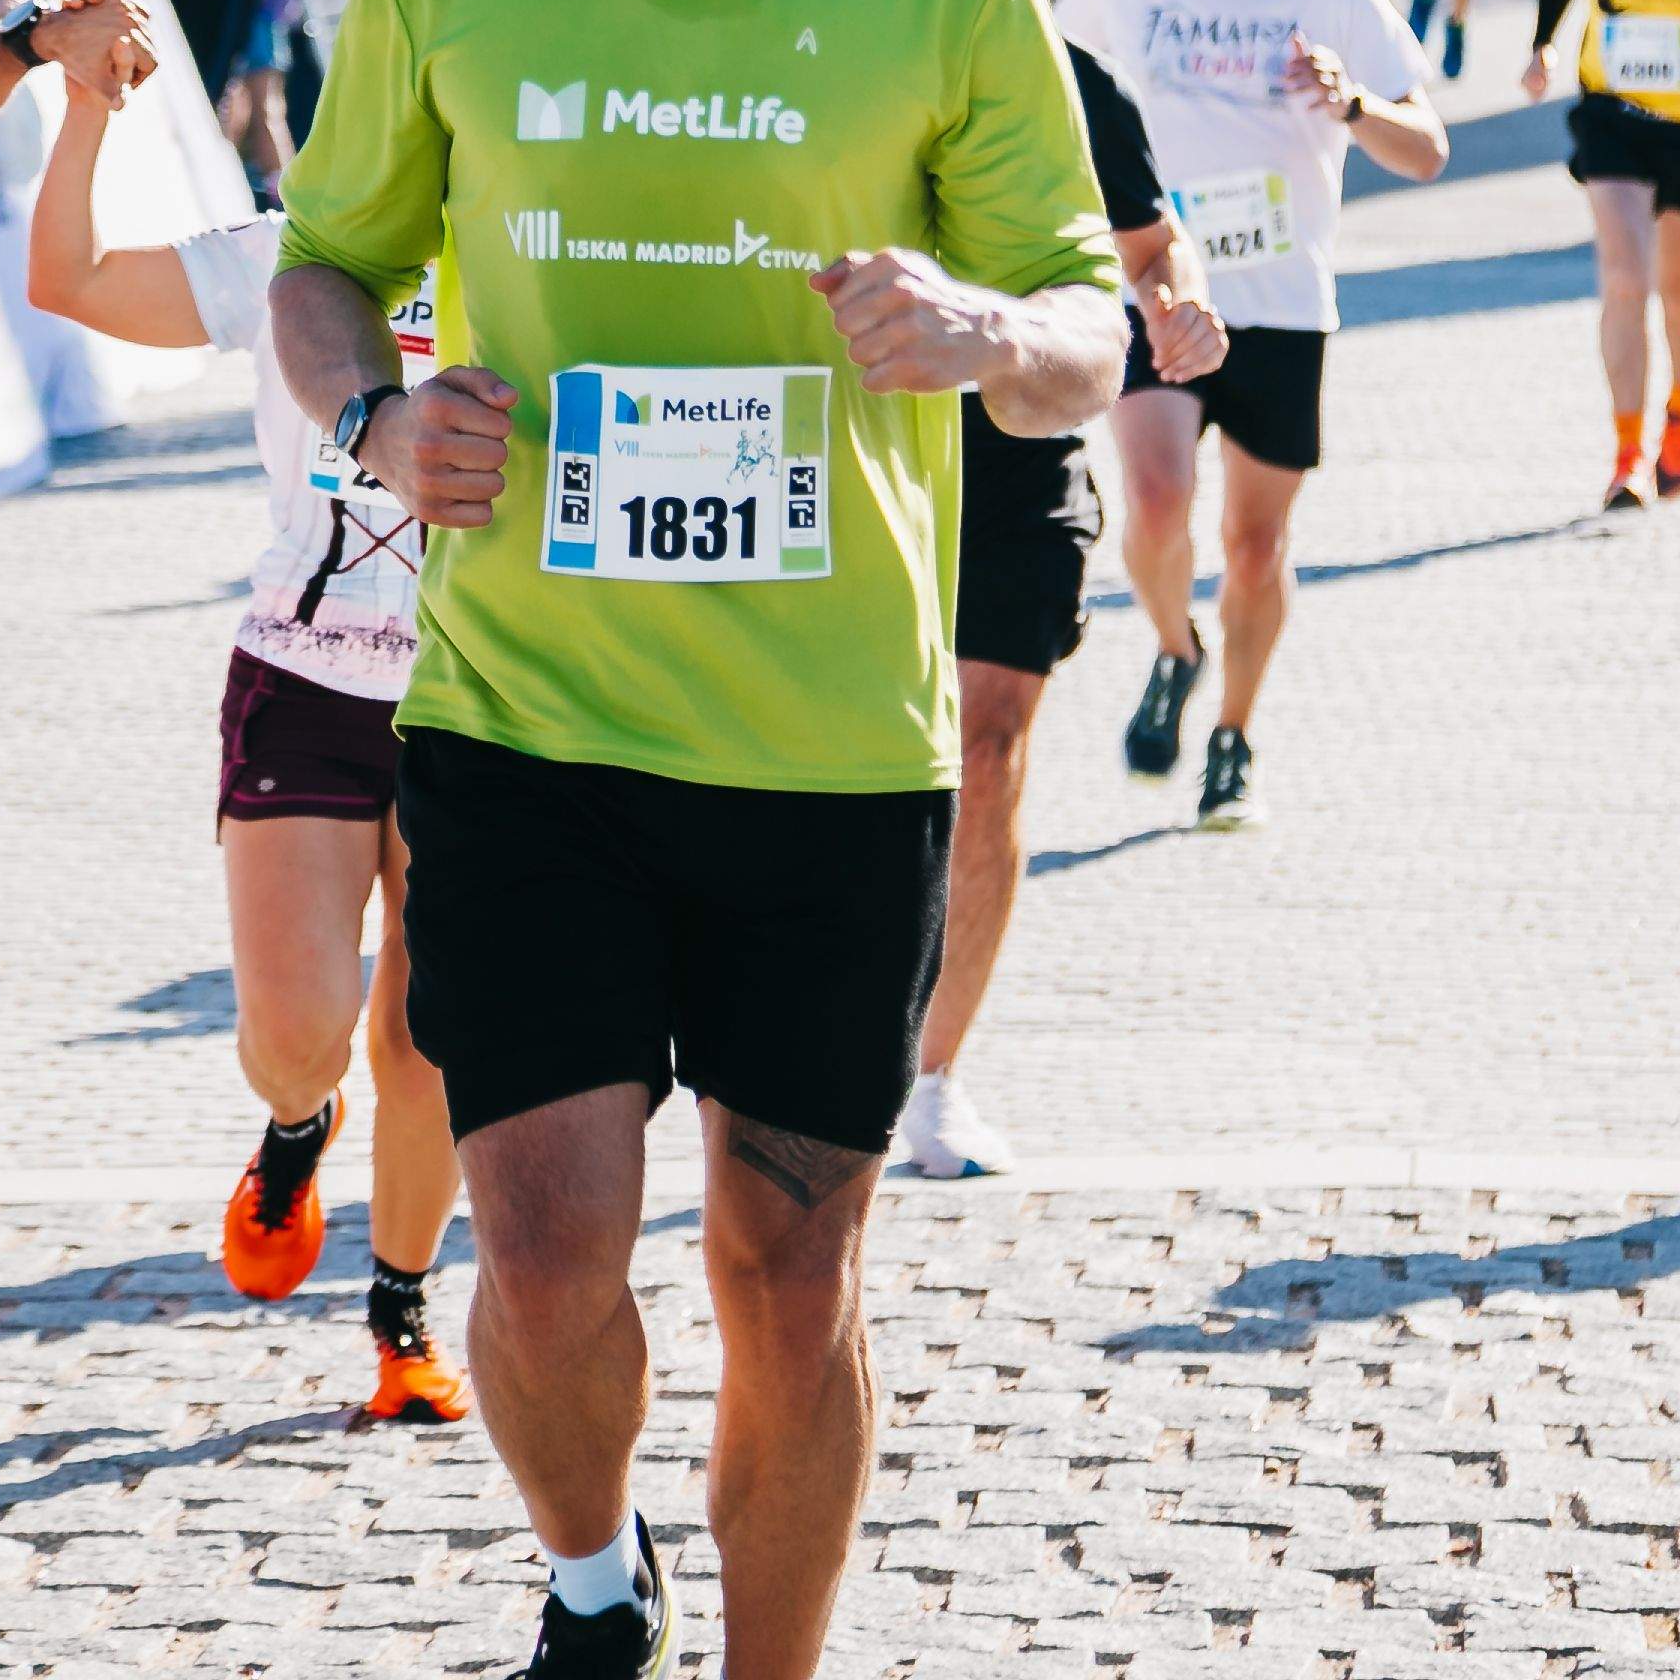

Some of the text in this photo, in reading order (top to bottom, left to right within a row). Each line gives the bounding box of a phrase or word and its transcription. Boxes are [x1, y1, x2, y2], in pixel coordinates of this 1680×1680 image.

[603, 89, 806, 143] MetLife
[504, 210, 559, 260] VIII
[567, 240, 627, 262] 15KM
[662, 397, 771, 422] MetLife
[619, 495, 757, 562] 1831
